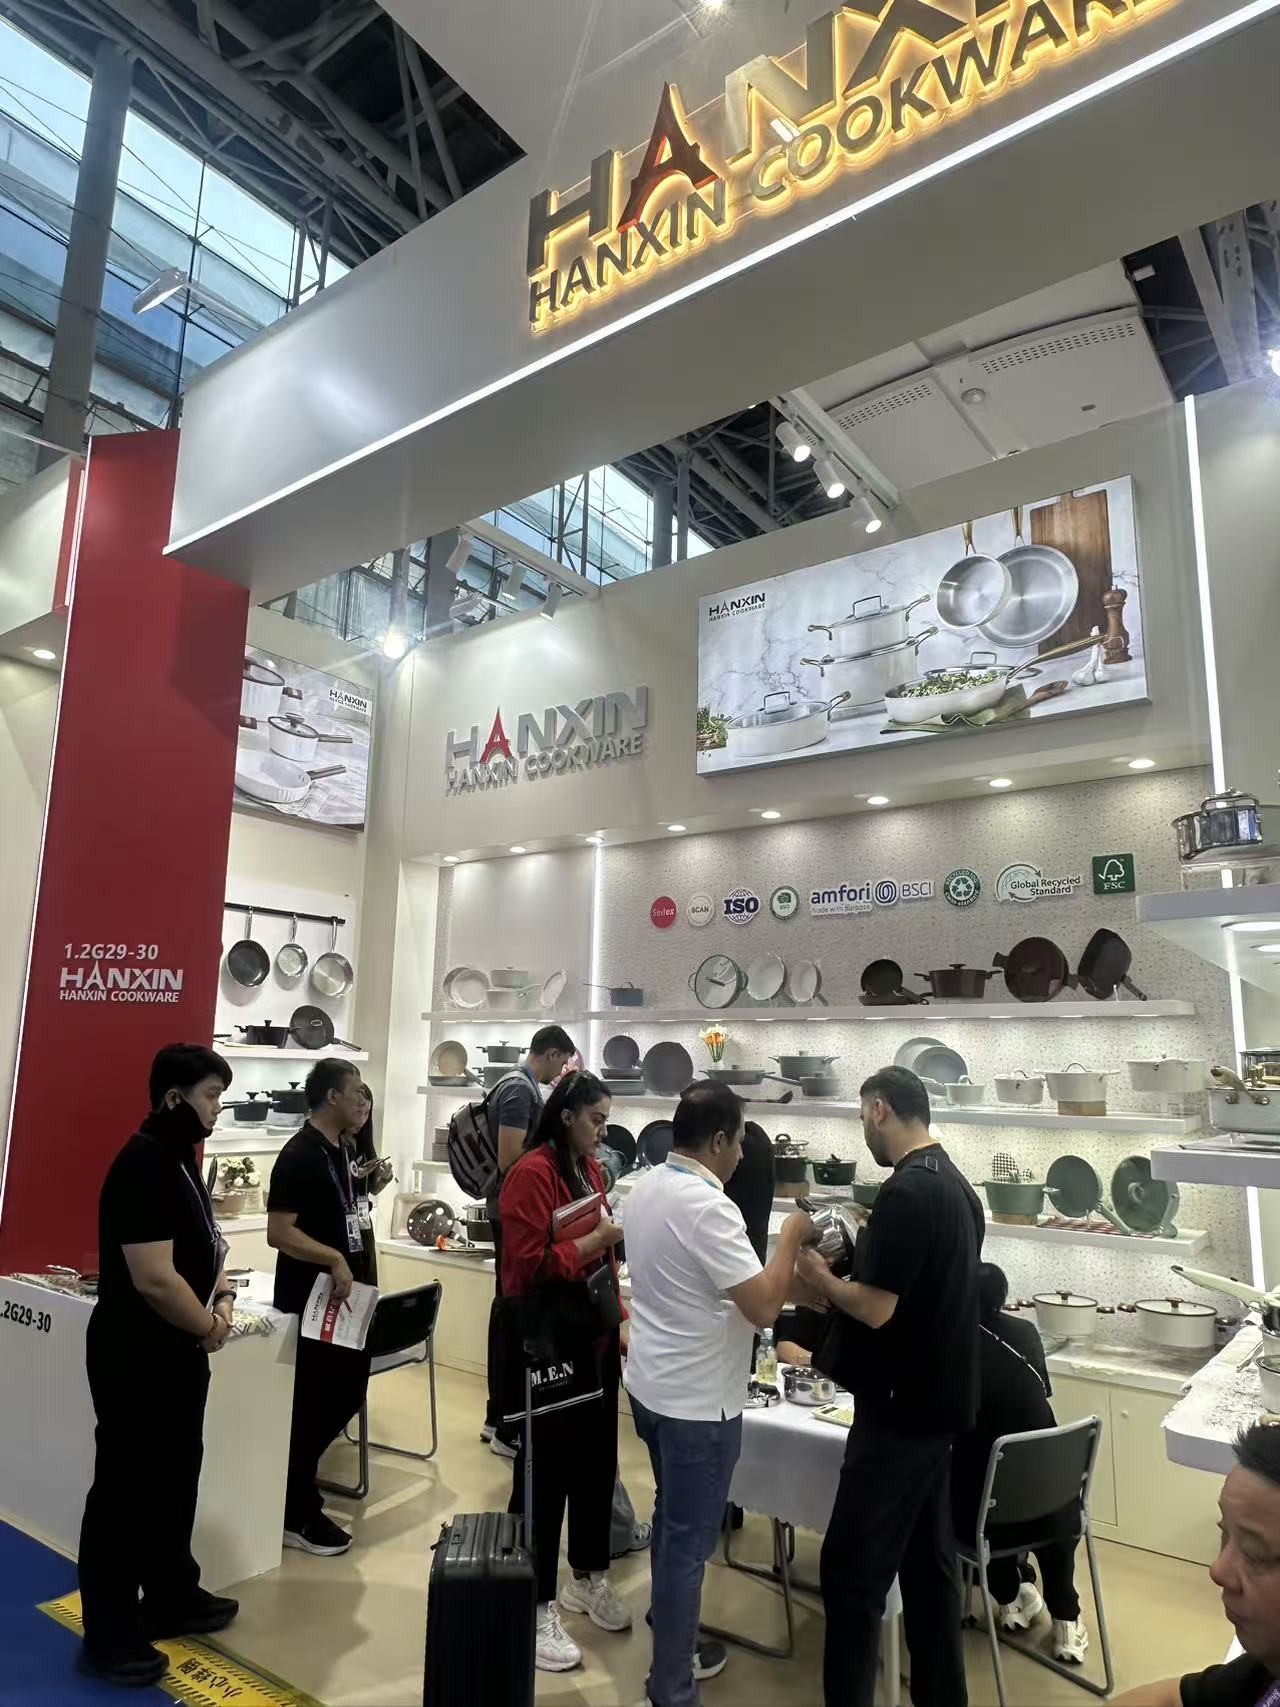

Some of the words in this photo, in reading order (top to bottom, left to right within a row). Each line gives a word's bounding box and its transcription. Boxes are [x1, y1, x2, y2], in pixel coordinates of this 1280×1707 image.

[527, 0, 1010, 277] HANX
[528, 178, 727, 323] HANXIN
[750, 0, 1148, 201] COOKWA
[709, 593, 766, 616] HANXIN
[330, 690, 367, 708] HANXIN
[446, 686, 649, 772] HANXIN
[447, 756, 519, 793] HANXIN
[525, 733, 644, 779] COOKWARE
[902, 882, 932, 897] BSCI
[1010, 879, 1039, 890] Global
[1040, 876, 1081, 888] Recycled
[1030, 885, 1072, 896] Standard
[1103, 881, 1127, 890] FSC
[811, 883, 871, 904] amfori
[690, 906, 709, 914] SCAN
[723, 897, 759, 915] ISO
[64, 943, 159, 960] 1.2G29-30
[60, 960, 184, 991] HANXIN
[60, 990, 107, 1001] HANXIN
[111, 991, 180, 1003] COOKWARE
